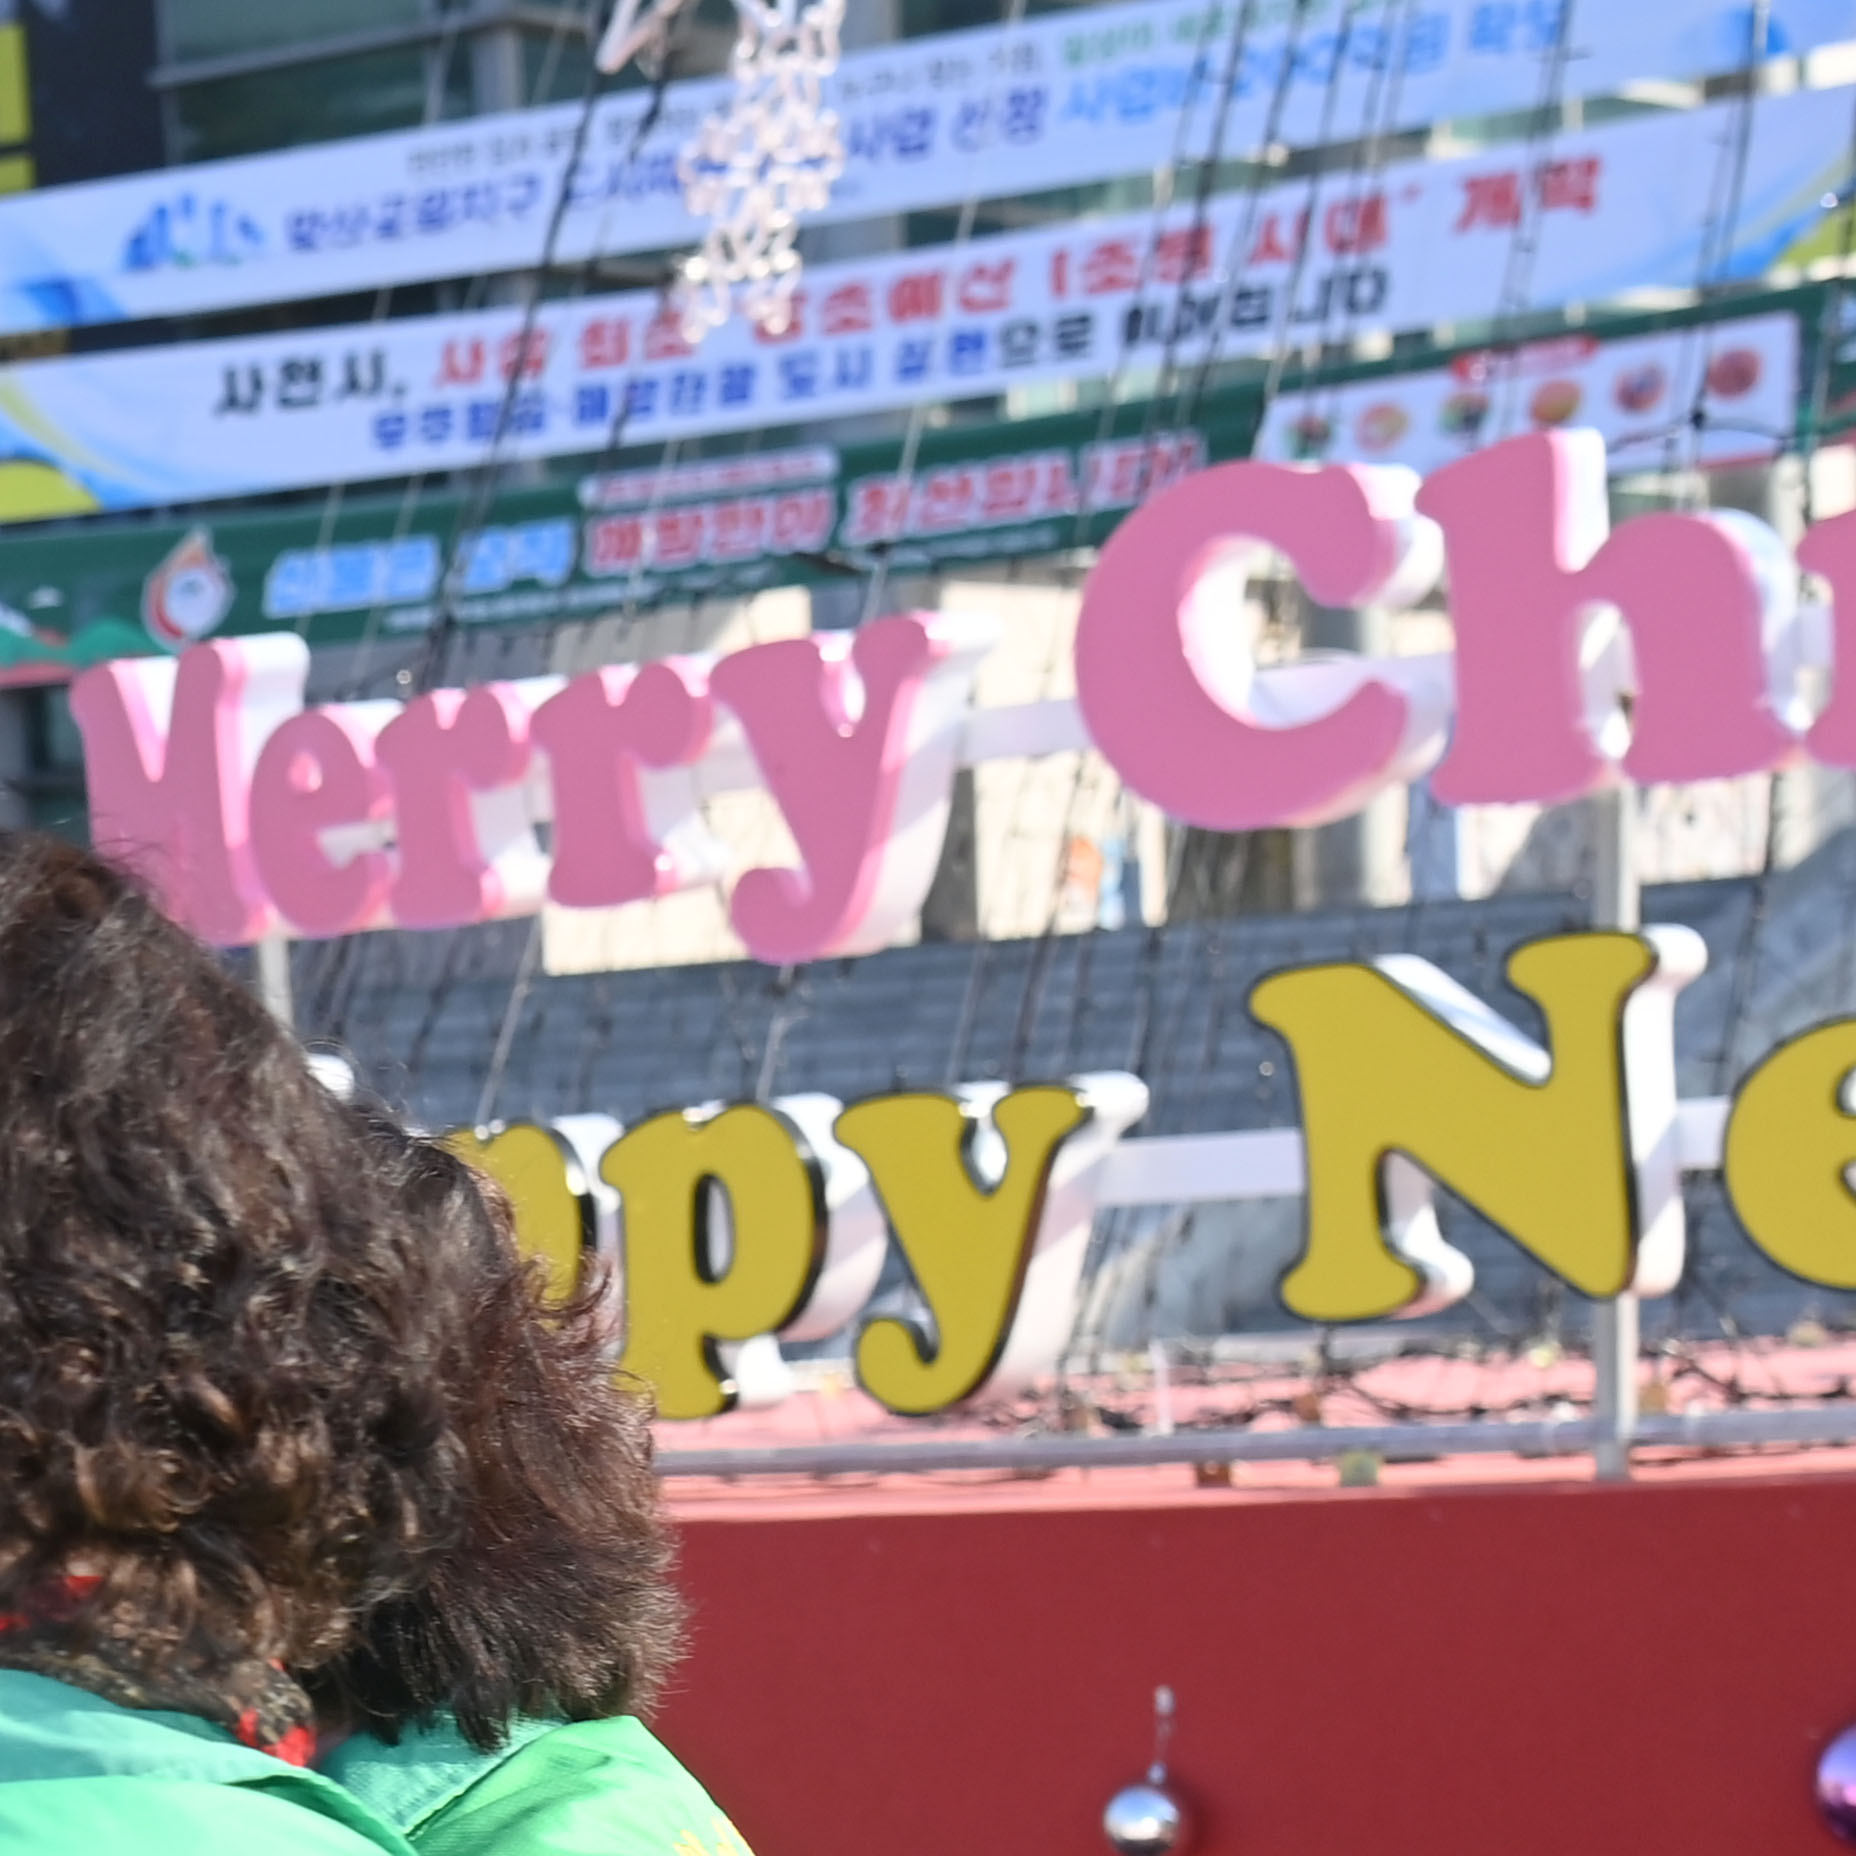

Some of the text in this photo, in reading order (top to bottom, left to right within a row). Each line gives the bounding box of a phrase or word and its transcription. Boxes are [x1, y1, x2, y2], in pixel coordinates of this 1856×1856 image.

[214, 347, 408, 417] 사천시,
[71, 427, 1856, 962] Merry Ch
